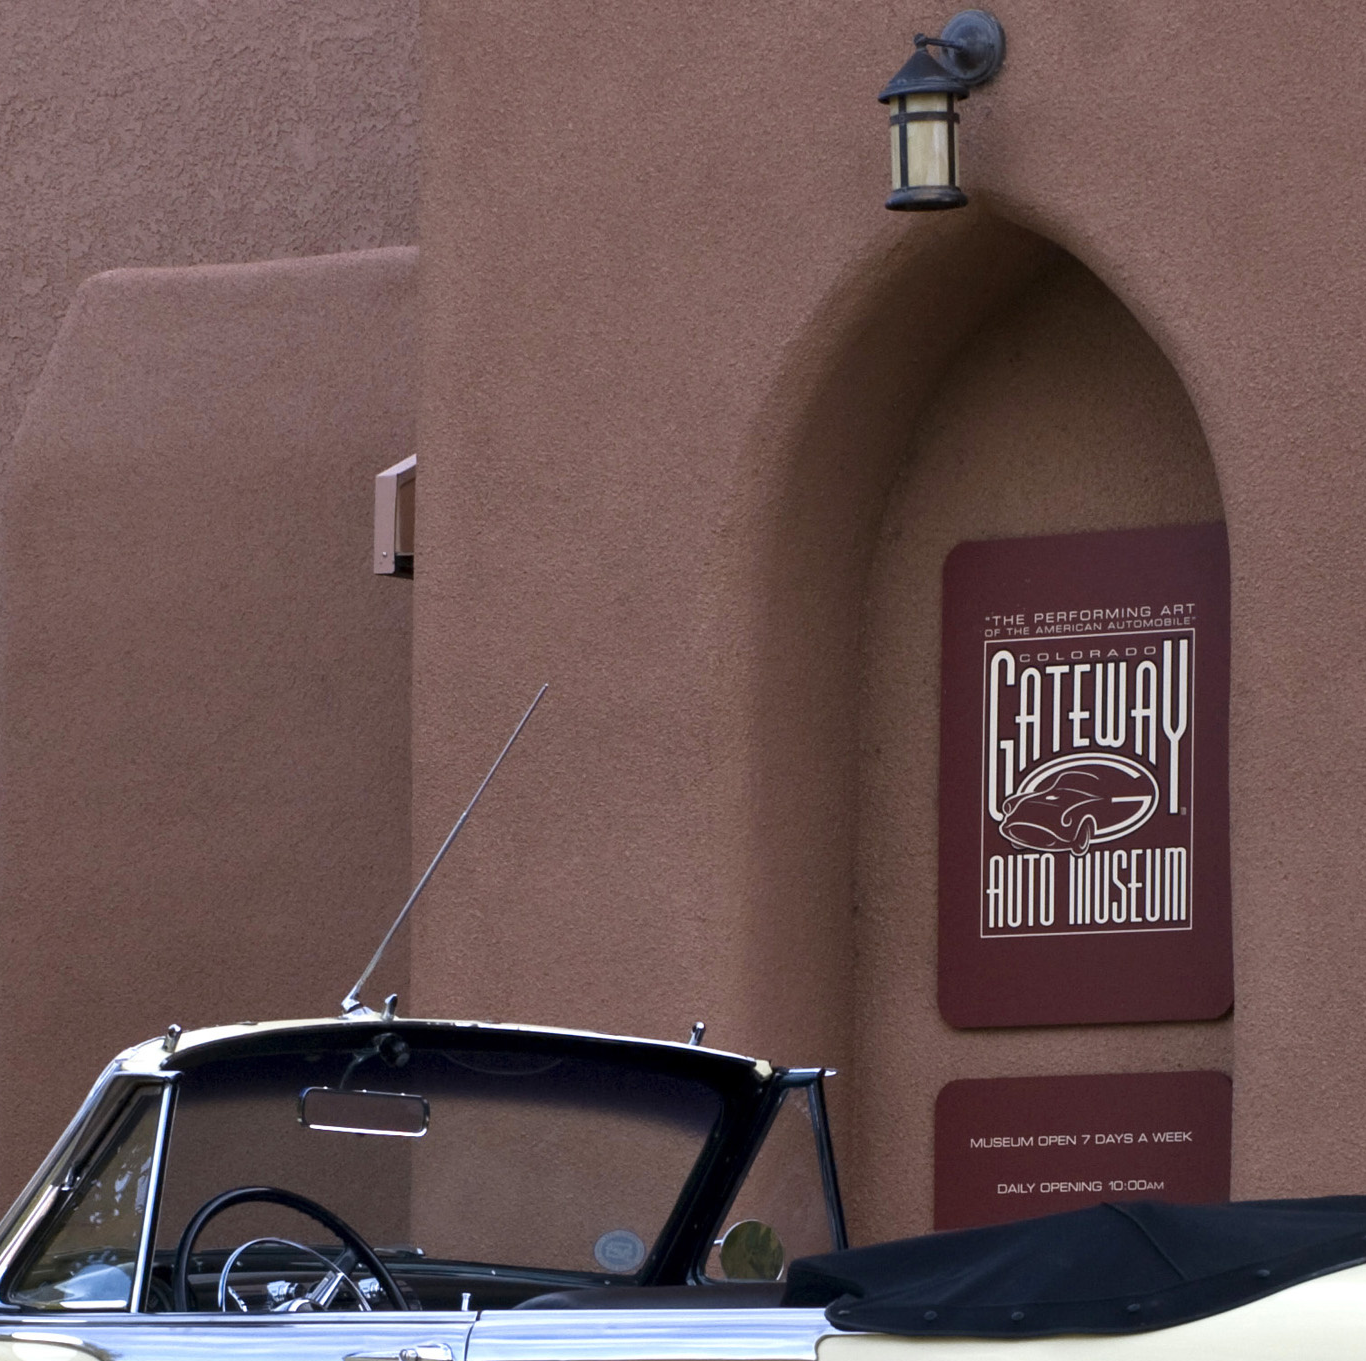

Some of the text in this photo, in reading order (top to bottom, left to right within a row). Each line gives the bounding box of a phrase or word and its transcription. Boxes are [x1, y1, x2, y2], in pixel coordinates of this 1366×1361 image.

[1034, 606, 1152, 624] PERFORMING
[1160, 603, 1196, 616] ART
[984, 628, 1001, 638] OF
[1006, 626, 1030, 637] THE
[1035, 622, 1103, 635] AMERICAN
[1019, 646, 1157, 663] COLORADO
[988, 639, 1188, 822] GATEWAY
[986, 847, 1187, 928] AUTO MUSEUM
[970, 1131, 1193, 1149] MUSEUM OPEN 7 DAYS A WEEK
[997, 1183, 1036, 1194] DAILY
[1040, 1180, 1103, 1193] OPENING
